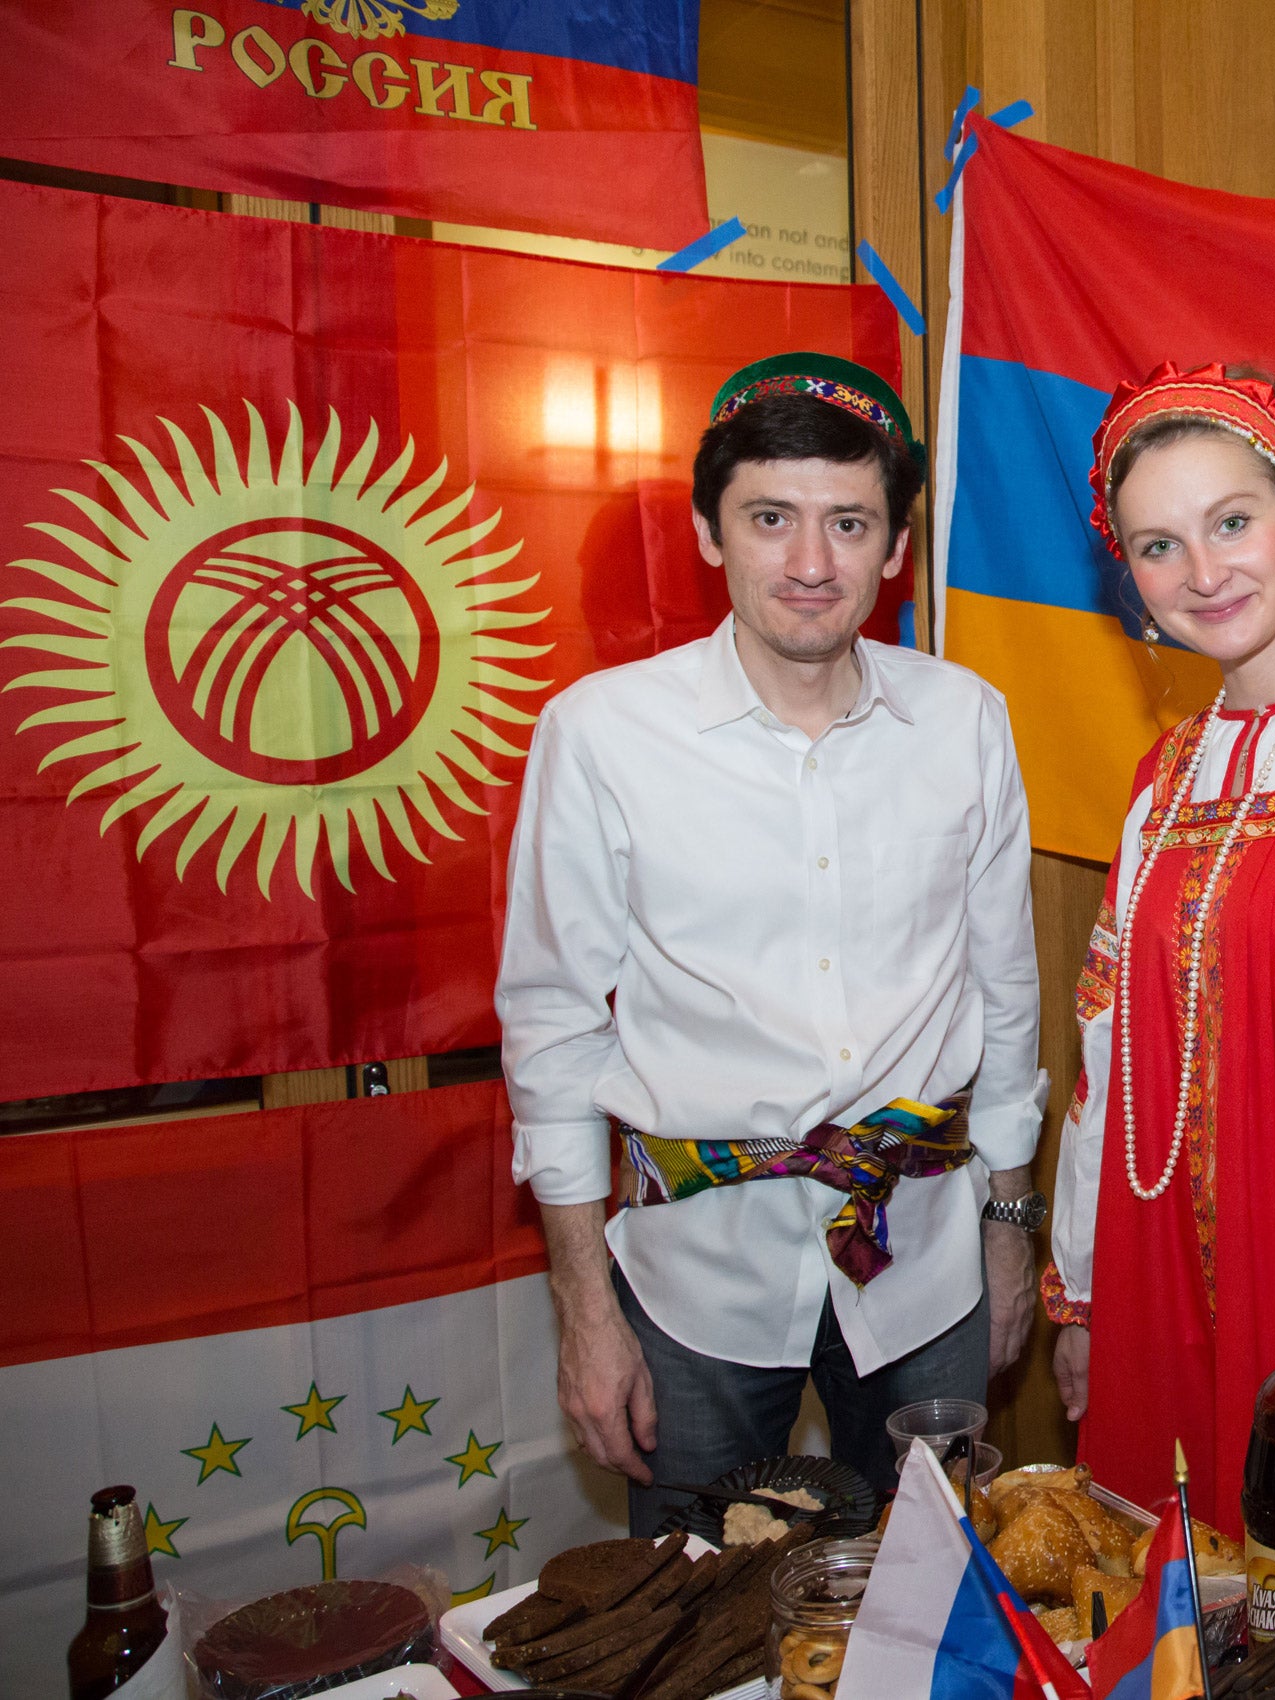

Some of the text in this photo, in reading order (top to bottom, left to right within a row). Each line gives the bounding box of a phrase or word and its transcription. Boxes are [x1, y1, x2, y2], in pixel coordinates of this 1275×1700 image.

[167, 8, 538, 131] РОССИЯ
[779, 228, 808, 244] not
[729, 250, 765, 268] into
